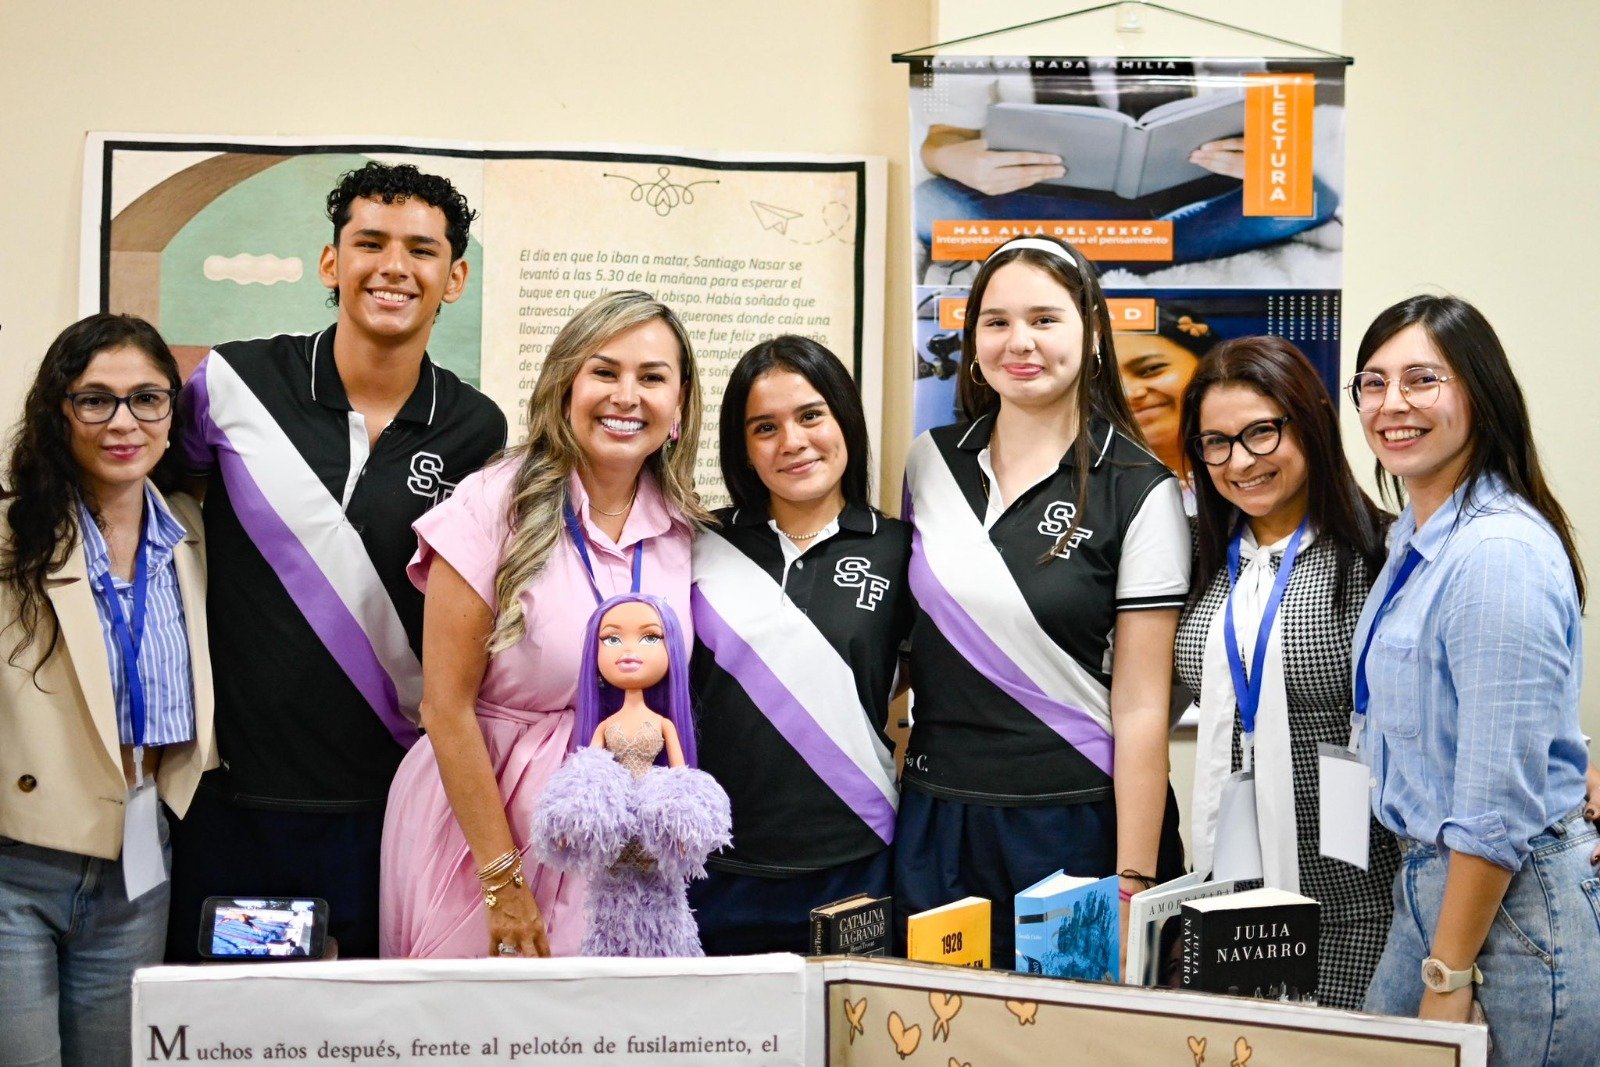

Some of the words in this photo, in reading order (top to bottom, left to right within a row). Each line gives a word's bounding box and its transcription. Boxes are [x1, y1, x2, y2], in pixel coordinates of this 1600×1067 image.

[963, 59, 986, 69] LA
[996, 59, 1086, 69] SAGRADA
[1096, 59, 1176, 70] FAMILIA
[1269, 80, 1288, 202] LECTURA
[1053, 226, 1087, 236] DEL
[1095, 226, 1154, 236] TEXTO
[1099, 236, 1169, 246] pensamiento
[519, 249, 530, 262] El
[532, 250, 550, 262] día
[552, 252, 567, 262] en
[570, 252, 594, 267] que
[596, 250, 608, 263] lo
[611, 251, 639, 264] iban
[641, 254, 650, 264] a
[652, 254, 690, 268] matar,
[692, 255, 746, 272] Santiago
[749, 258, 786, 271] Nasar
[788, 260, 802, 271] se
[519, 267, 559, 281] levantó
[562, 270, 570, 281] a
[573, 268, 592, 282] las
[595, 269, 624, 282] 5.30
[626, 269, 643, 283] de
[645, 270, 656, 283] la
[659, 273, 707, 286] mañana
[709, 277, 738, 290] para
[741, 277, 788, 291] esperar
[790, 276, 802, 290] el
[518, 286, 553, 302] buque
[555, 289, 570, 299] en
[573, 289, 597, 304] que
[661, 290, 703, 306] obispo.
[705, 292, 742, 306] Había
[745, 292, 790, 308] soñado
[792, 297, 816, 310] que
[675, 310, 733, 325] iguerones
[736, 312, 775, 326] donde
[777, 313, 804, 326] caía
[806, 315, 831, 327] una
[518, 322, 561, 335] llovizna
[707, 329, 728, 344] fue
[730, 328, 756, 344] feliz
[518, 342, 543, 356] pero
[518, 359, 533, 372] de
[833, 556, 891, 612] SF
[839, 907, 885, 932] CATALINA
[850, 922, 886, 944] GRANDE
[1234, 922, 1291, 941] JULIA
[941, 931, 963, 955] 1928
[1183, 918, 1192, 985] NAVARRO
[1192, 933, 1200, 975] JULIA
[1216, 941, 1307, 963] NAVARRO
[147, 1024, 253, 1061] Muchos
[262, 1041, 308, 1060] años
[317, 1039, 402, 1067] después,
[411, 1037, 471, 1059] frente
[481, 1036, 499, 1056] al
[509, 1036, 583, 1061] pelotón
[593, 1035, 617, 1055] de
[627, 1034, 752, 1057] fusilamiento,
[761, 1034, 779, 1054] el
